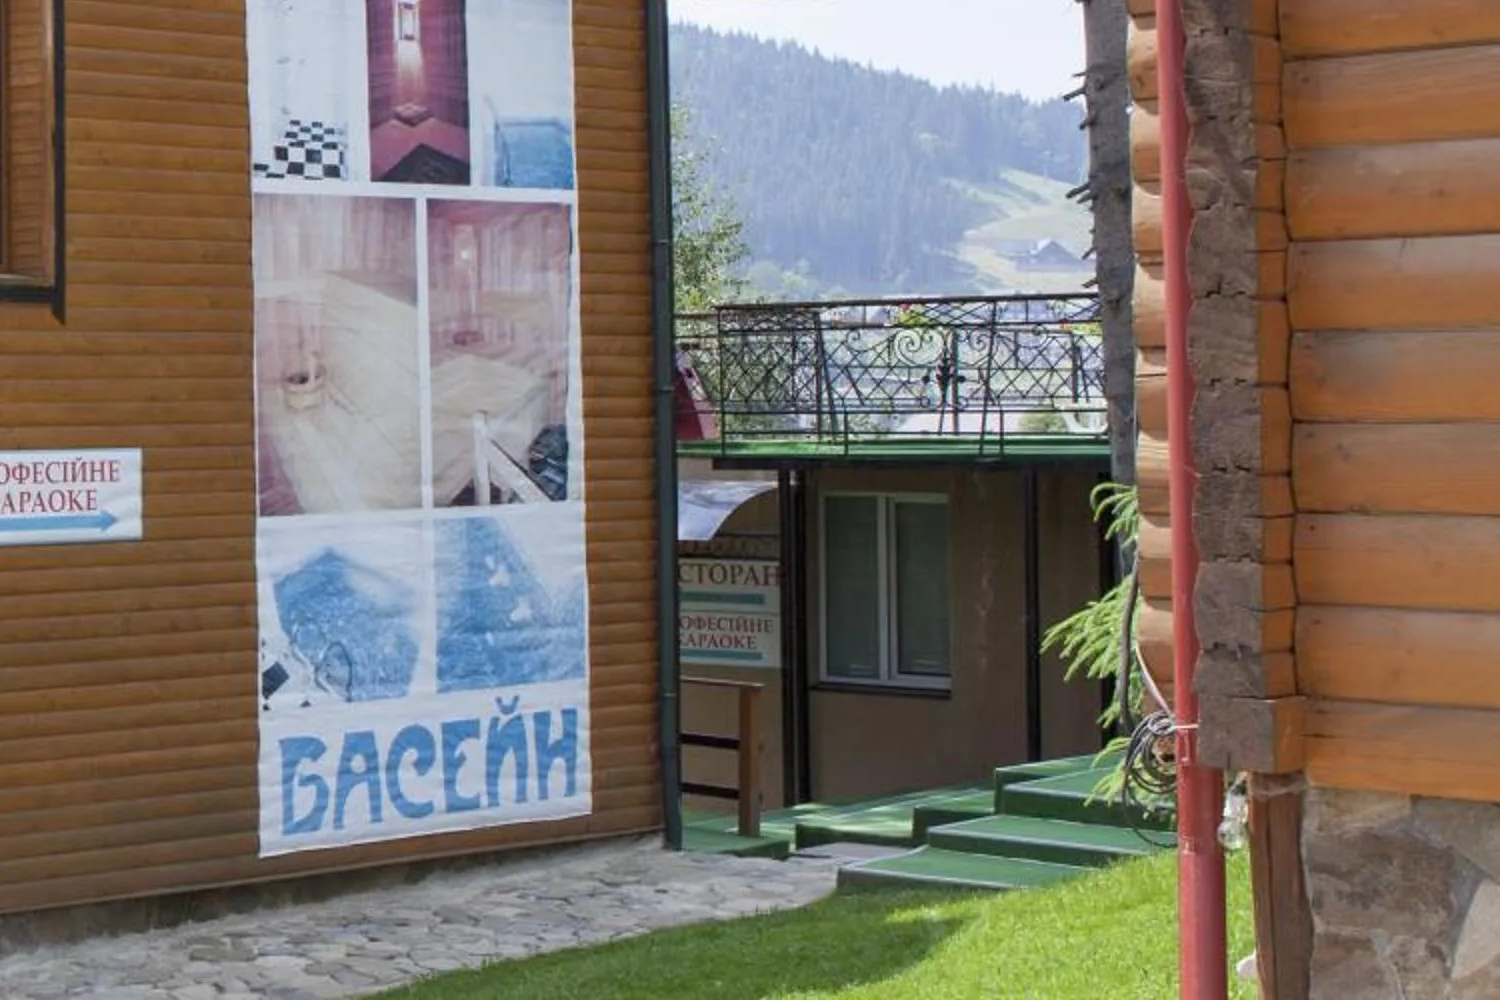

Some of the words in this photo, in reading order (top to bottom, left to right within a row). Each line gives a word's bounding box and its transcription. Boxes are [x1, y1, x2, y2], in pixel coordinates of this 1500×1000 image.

[677, 562, 785, 587] СТОРАН
[677, 614, 773, 634] ОФЕСІЙНЕ
[278, 695, 578, 836] БАСЕЙН
